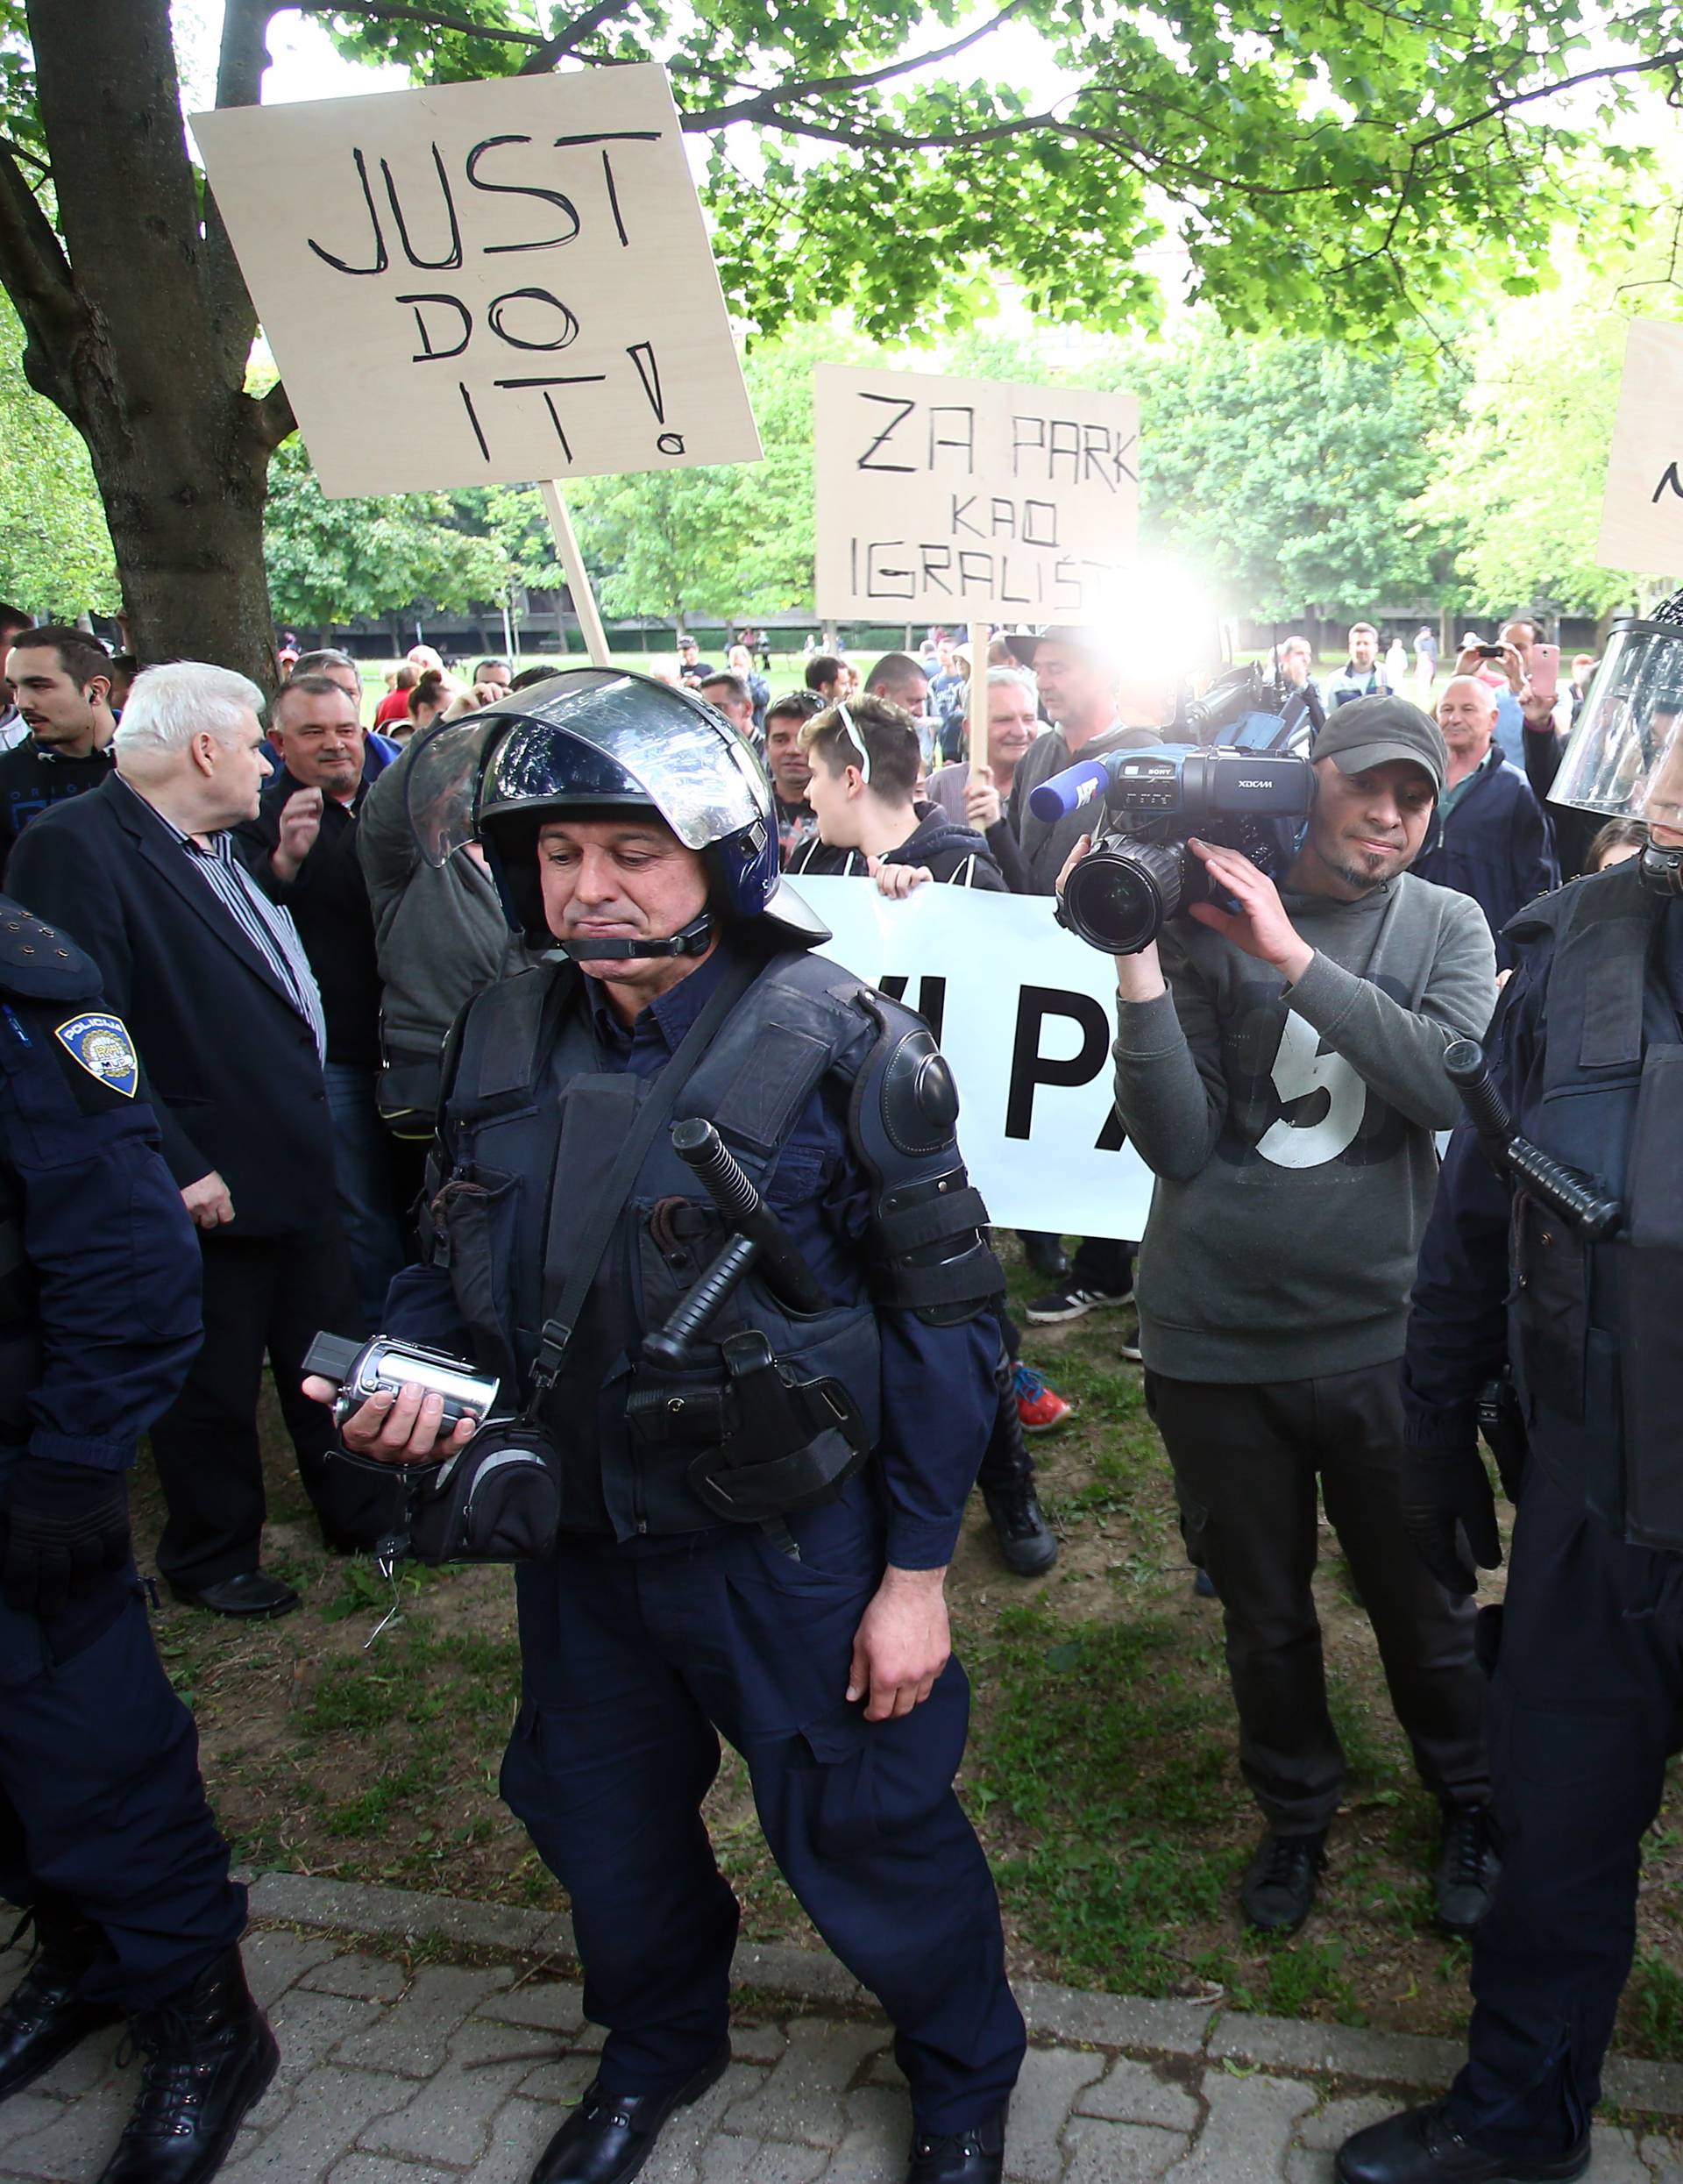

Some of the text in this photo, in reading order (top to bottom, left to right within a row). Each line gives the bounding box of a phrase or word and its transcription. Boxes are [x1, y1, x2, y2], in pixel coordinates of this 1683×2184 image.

[308, 132, 662, 274] JUST
[395, 288, 579, 362] DO
[459, 342, 685, 465] IT!
[857, 392, 1139, 492] ZA PARK
[952, 494, 1060, 547] KAO
[852, 537, 1127, 610] IGRALIŠT
[63, 1018, 124, 1041] POLICIJA
[101, 1057, 125, 1068] MUP
[1005, 985, 1127, 1152] P
[1255, 1008, 1367, 1169] 5
